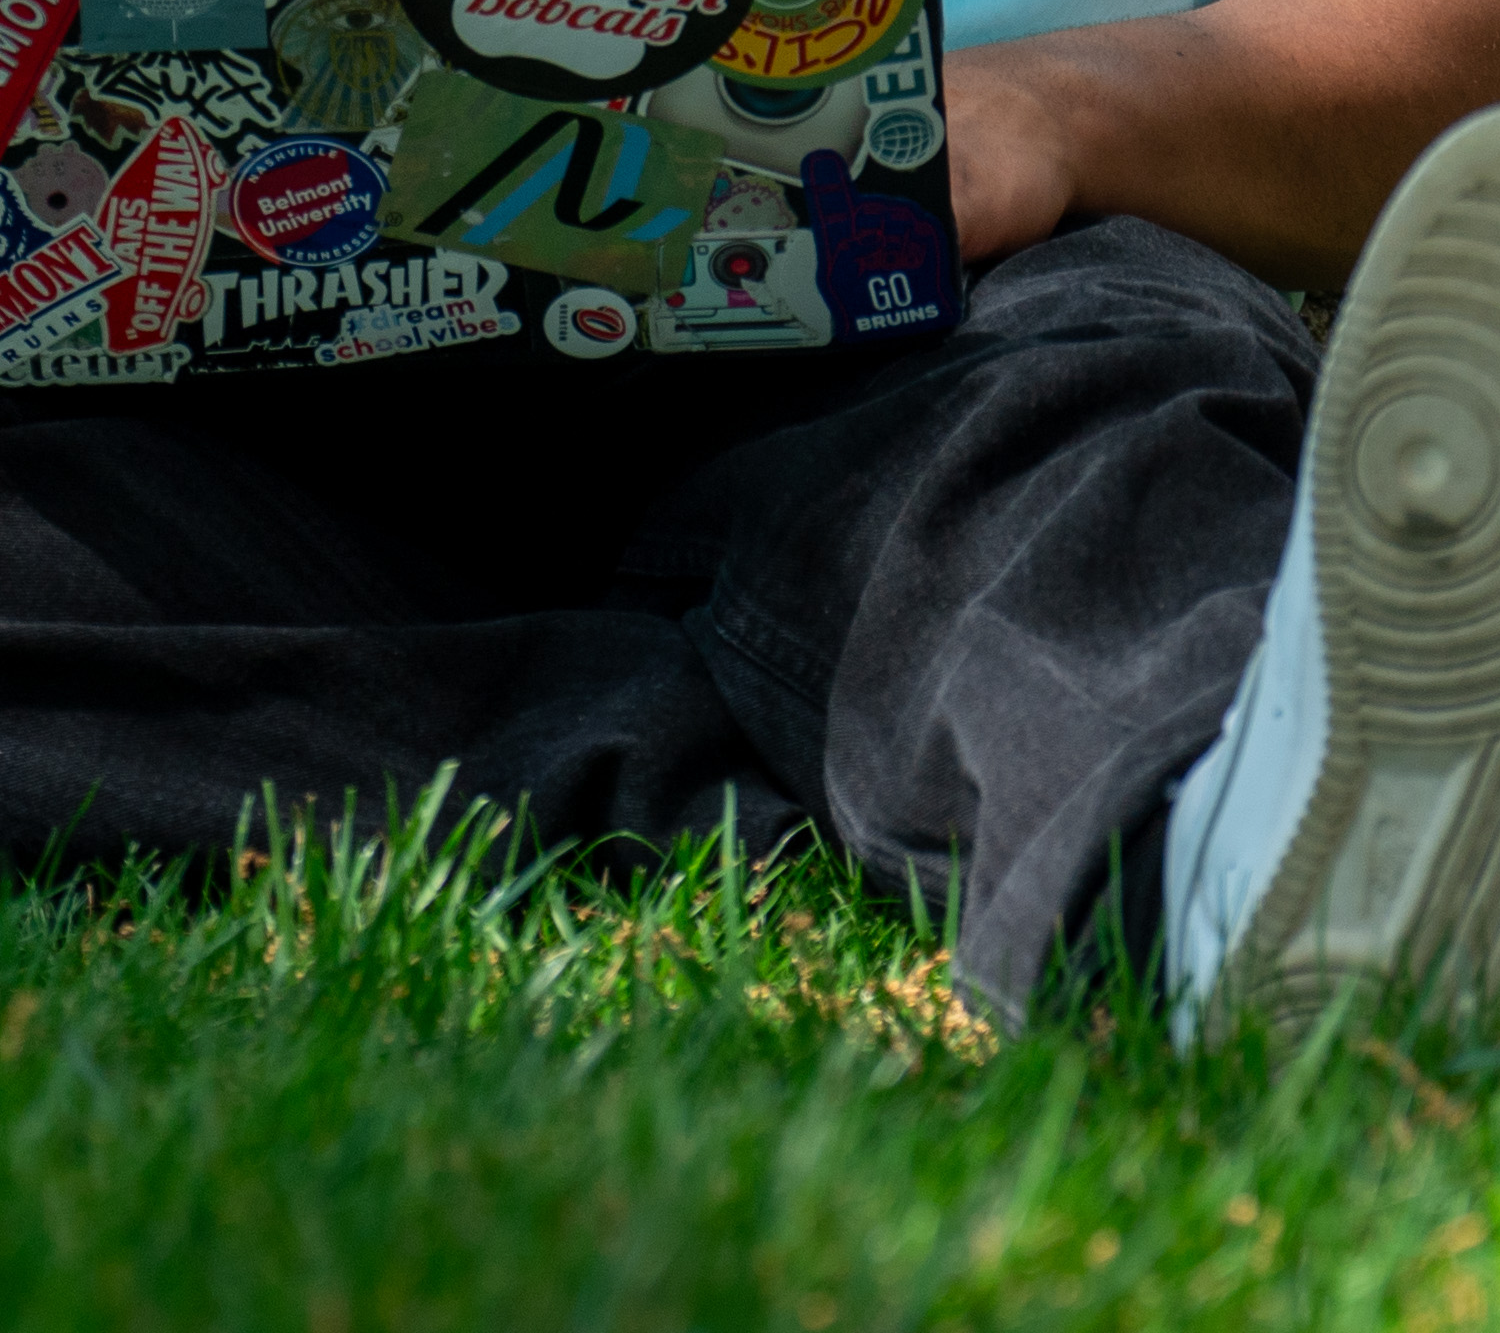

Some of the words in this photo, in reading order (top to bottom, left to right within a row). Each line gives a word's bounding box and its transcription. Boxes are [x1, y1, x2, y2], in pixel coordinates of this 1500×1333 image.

[248, 146, 339, 184] NASHVILLE
[257, 172, 354, 216] Belmont
[258, 192, 372, 238] University
[141, 215, 198, 276] THE
[285, 222, 376, 262] TENNESSEE
[202, 255, 508, 350] THRASHER
[867, 271, 913, 313] GO
[320, 326, 422, 362] school
[430, 317, 516, 342] vibes
[856, 304, 939, 333] BRUINS
